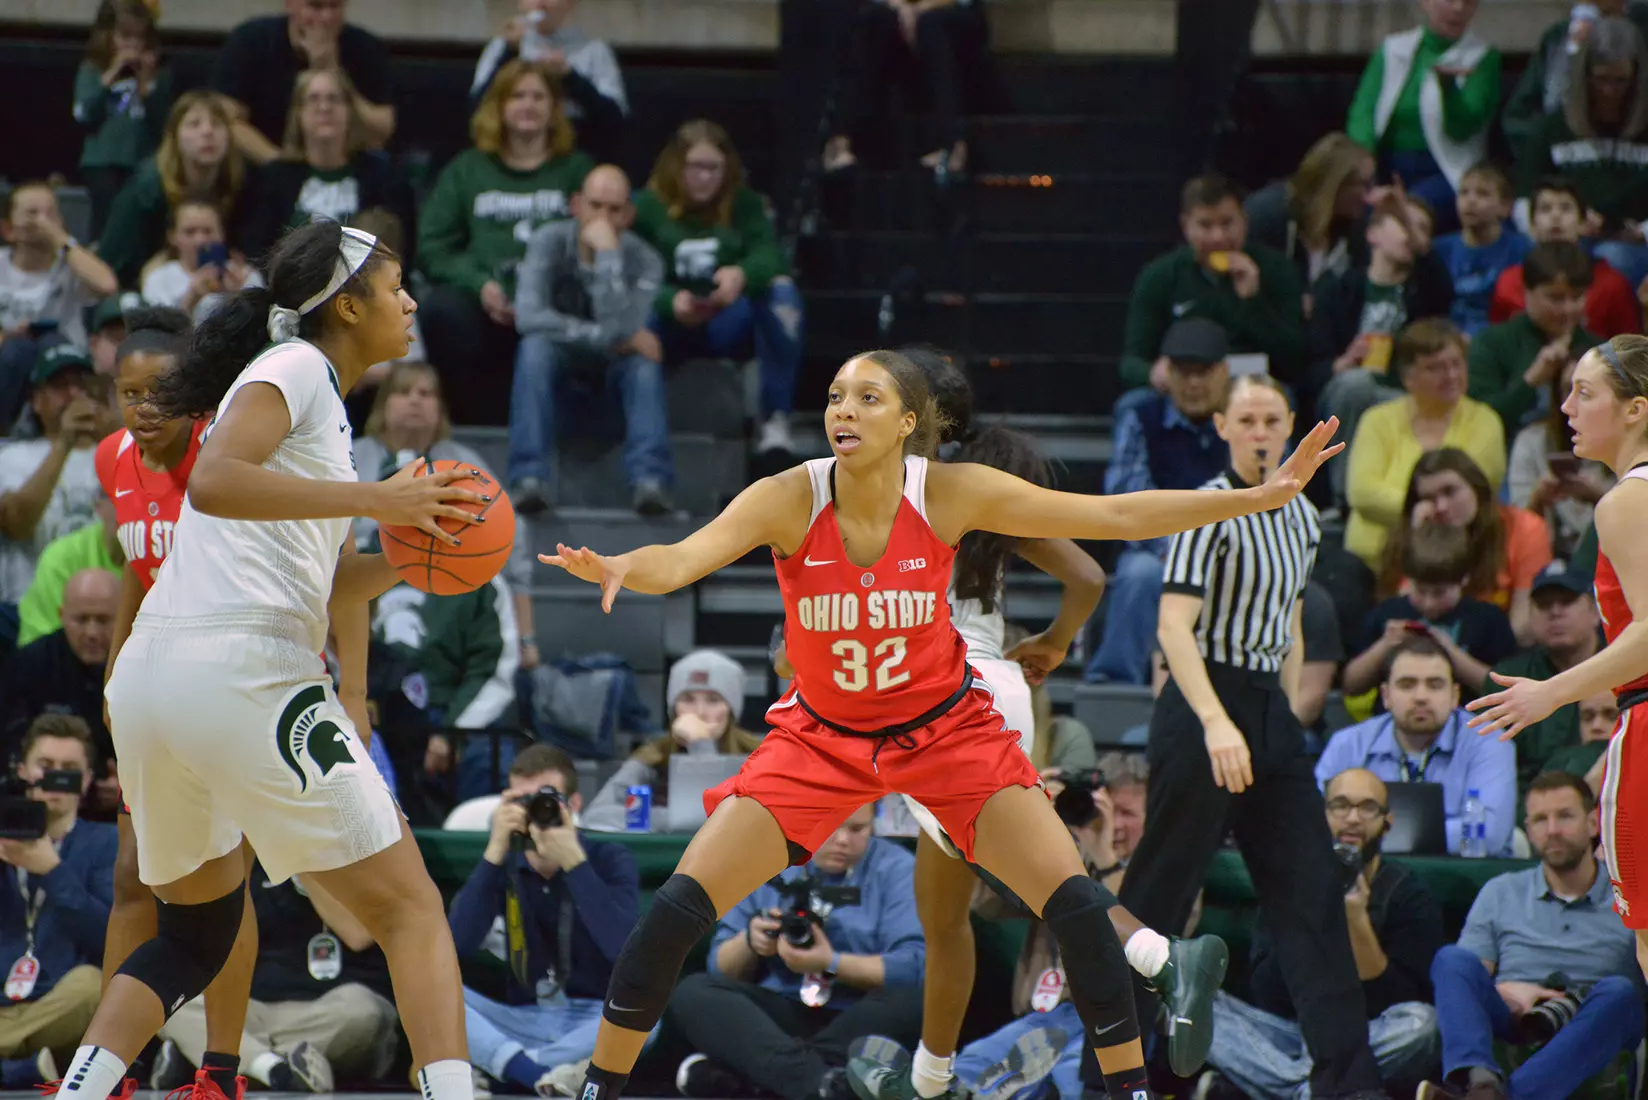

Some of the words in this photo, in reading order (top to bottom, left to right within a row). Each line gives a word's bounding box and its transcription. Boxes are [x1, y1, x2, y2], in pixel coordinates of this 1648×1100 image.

[798, 593, 859, 632] OHIO
[867, 589, 936, 630] STATE
[831, 635, 911, 692] 32
